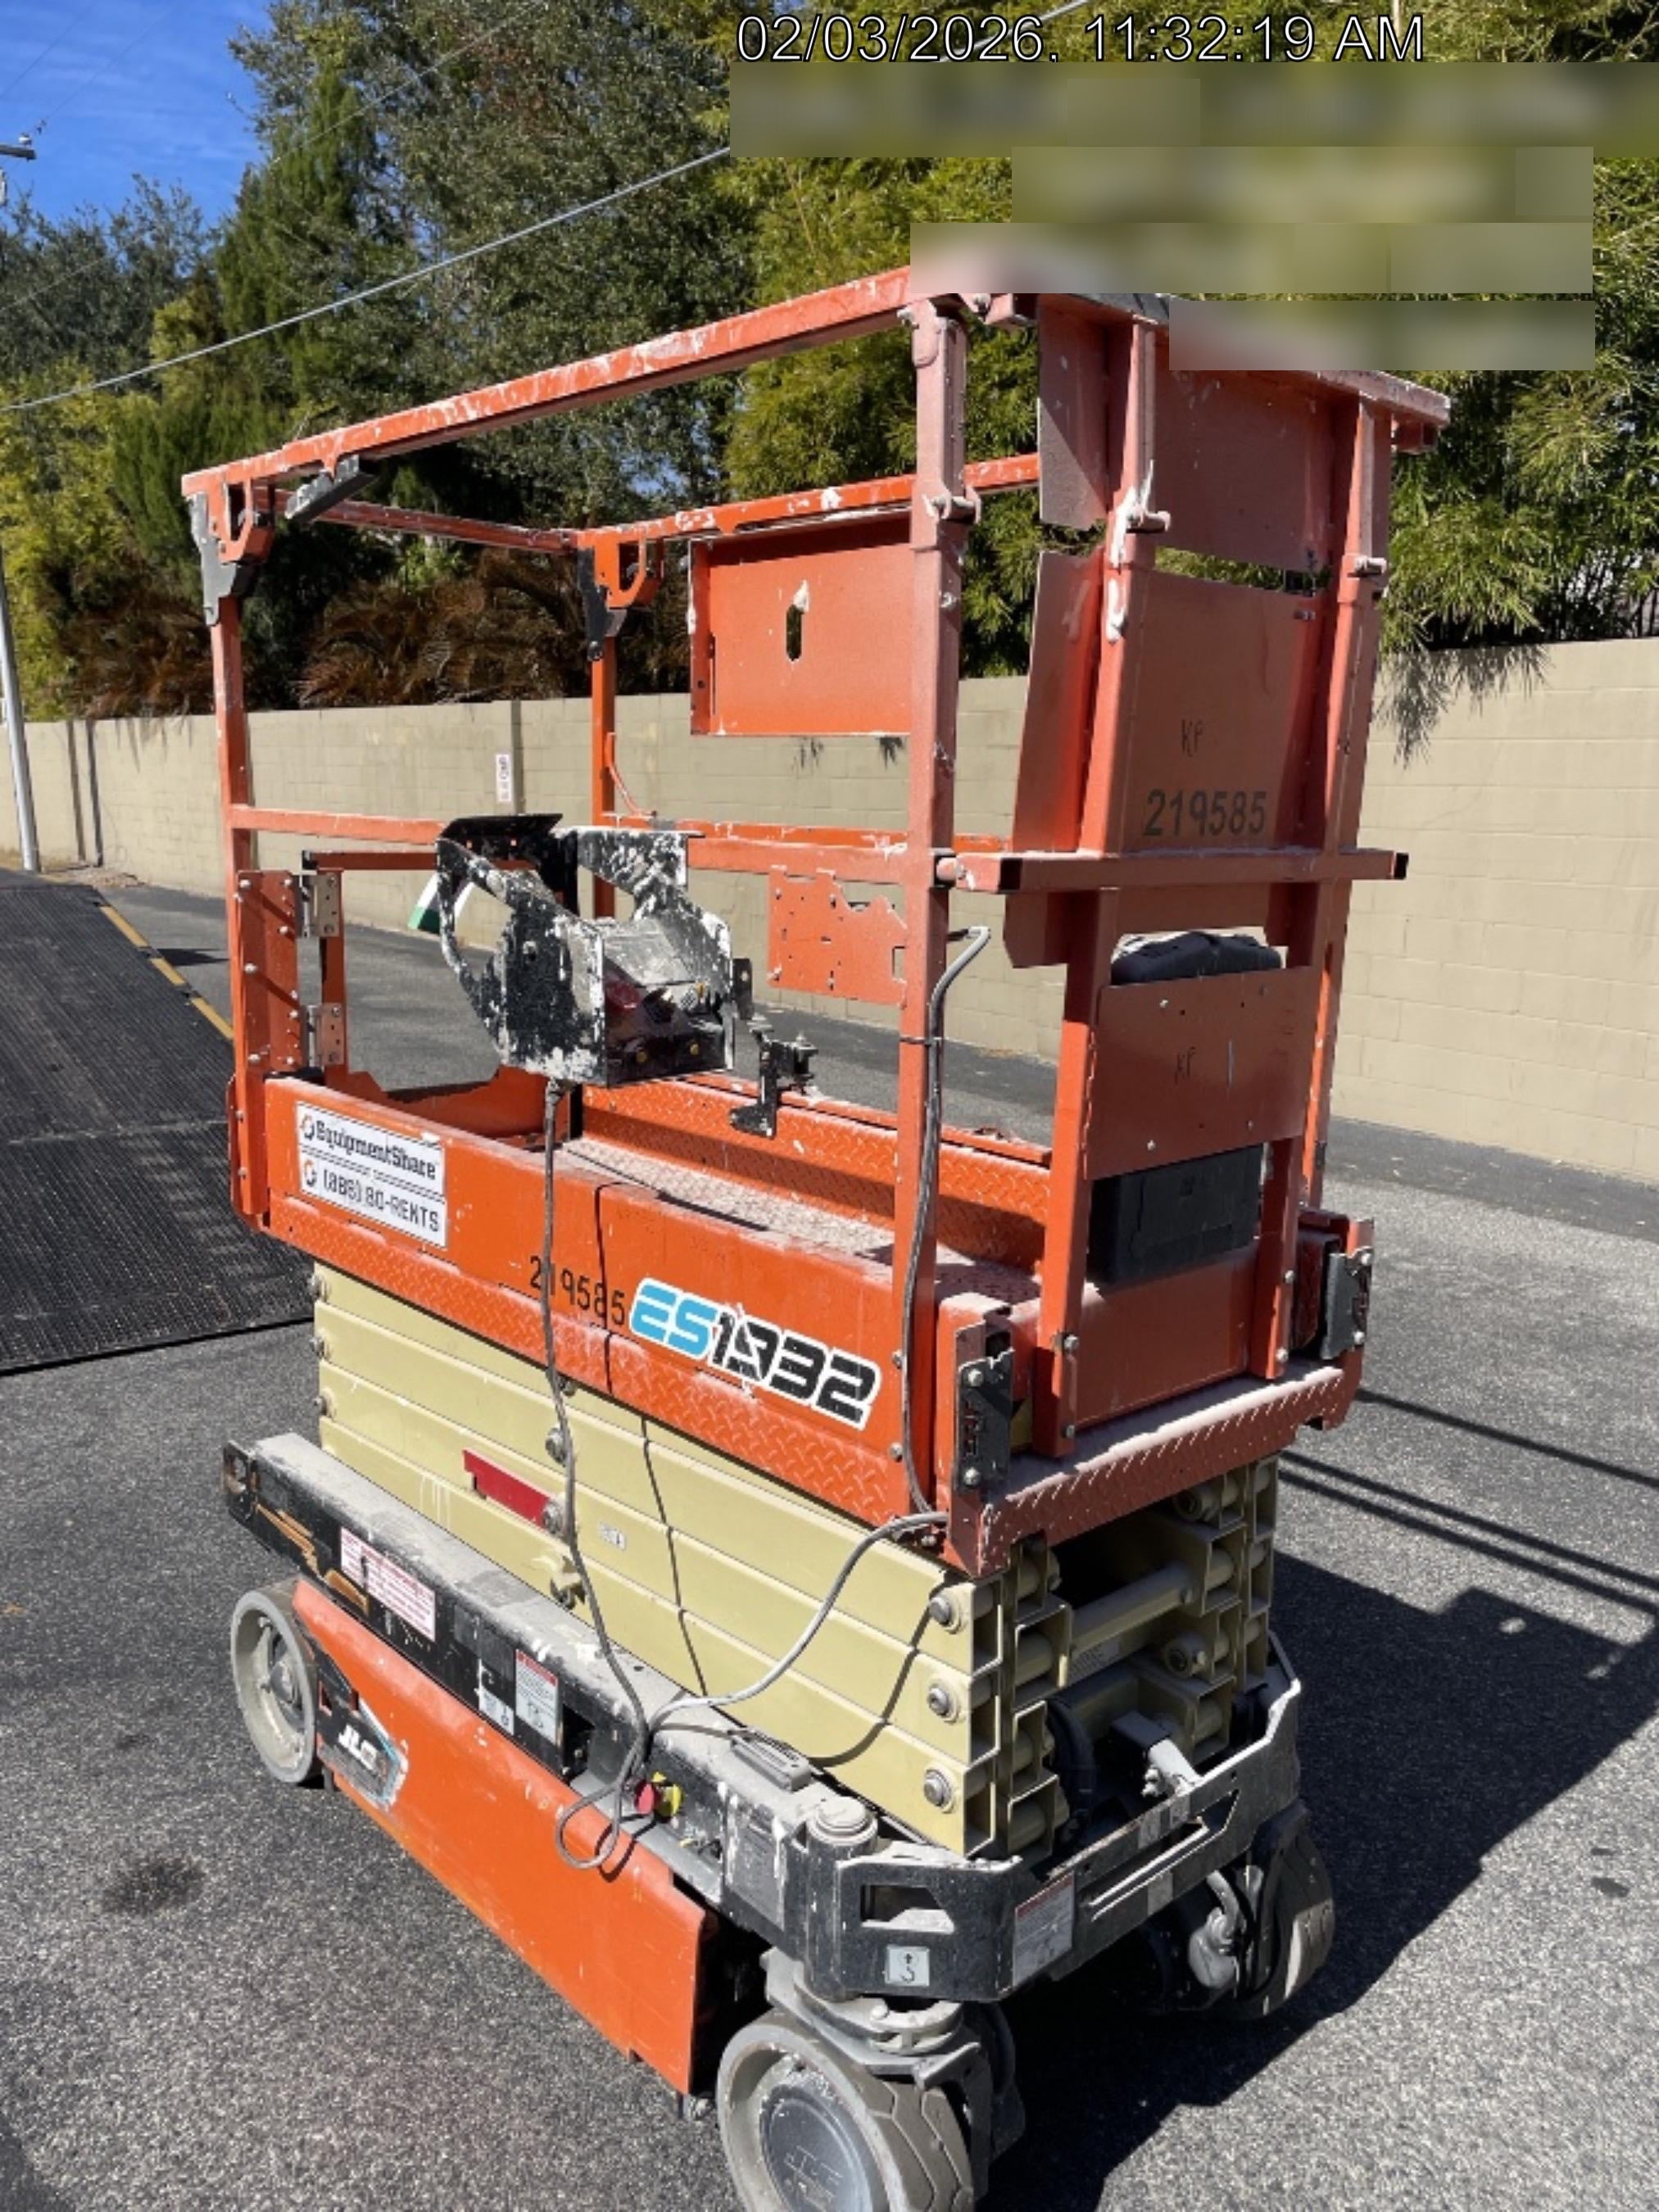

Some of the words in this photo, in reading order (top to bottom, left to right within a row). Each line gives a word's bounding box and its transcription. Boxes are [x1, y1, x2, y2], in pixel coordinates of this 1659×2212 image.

[1142, 789, 1267, 836] 219585
[315, 1120, 436, 1181] EquipmentShare
[631, 1281, 877, 1426] ES1932
